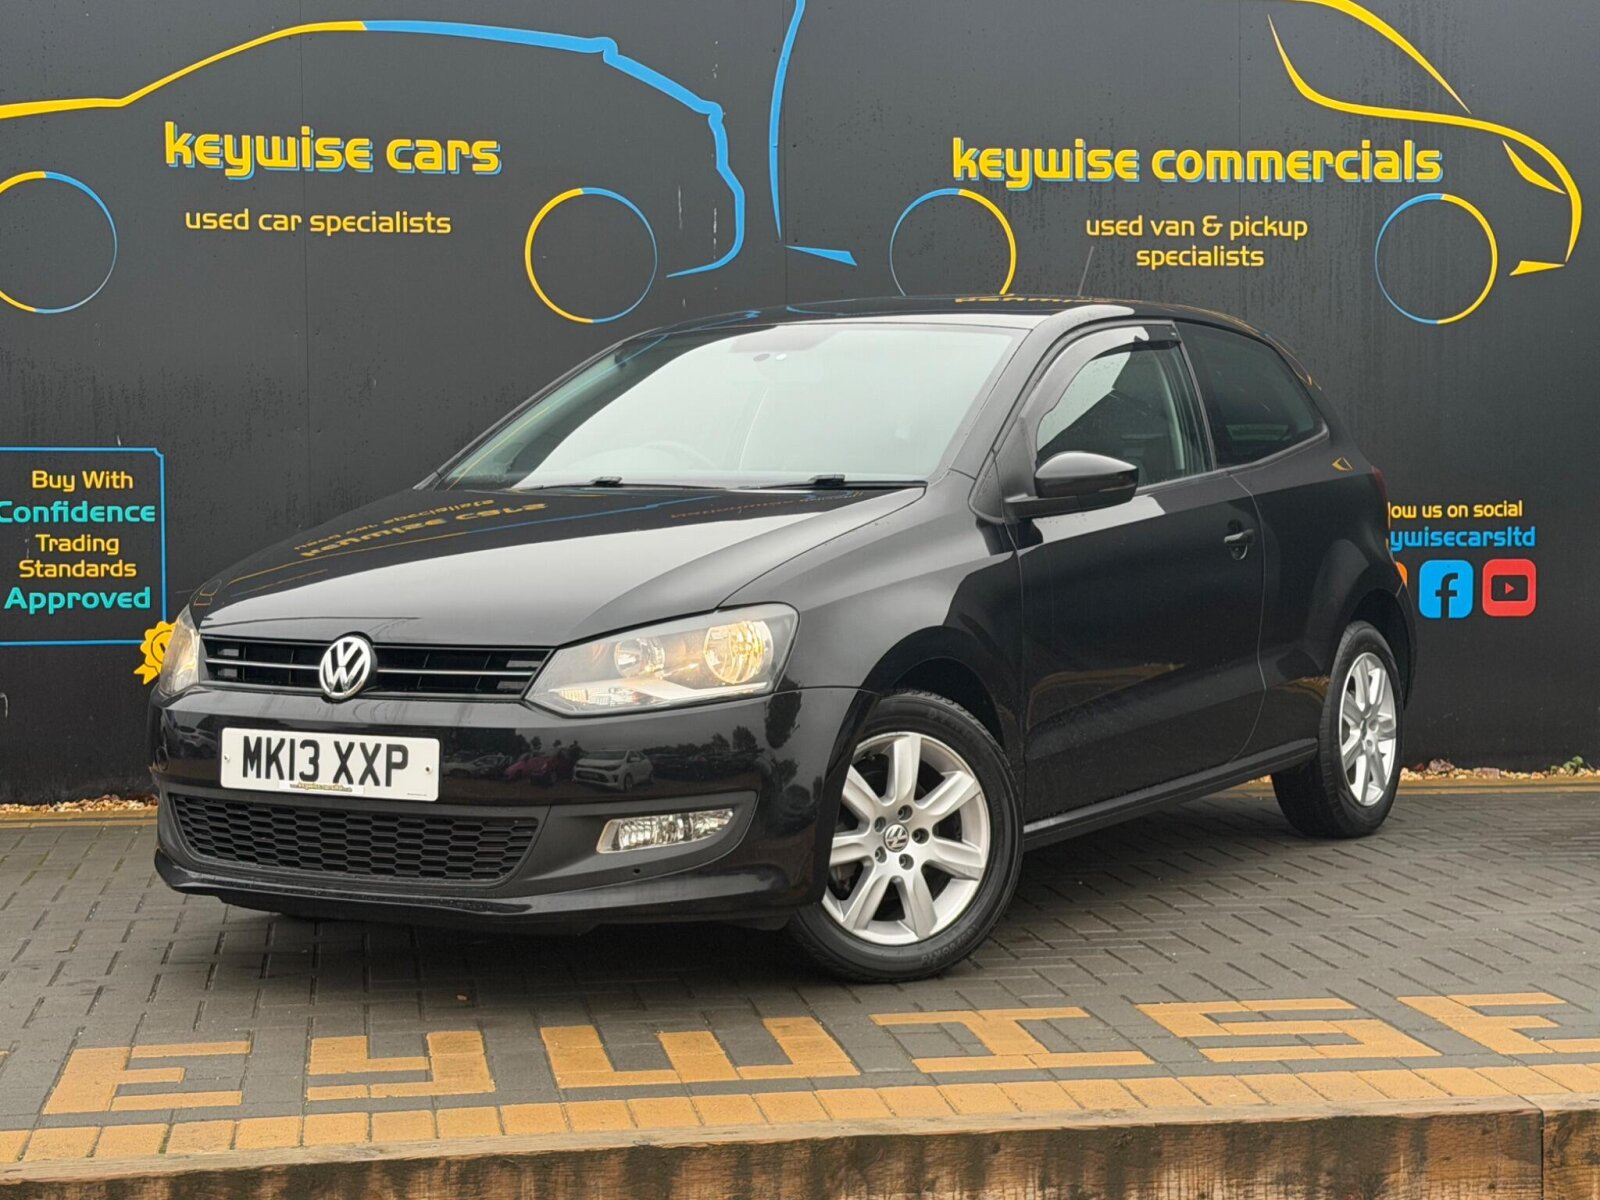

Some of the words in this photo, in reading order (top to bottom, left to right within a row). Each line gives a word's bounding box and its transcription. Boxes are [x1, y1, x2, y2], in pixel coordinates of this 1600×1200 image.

[164, 121, 373, 181] keywise
[386, 138, 502, 175] cars
[952, 137, 1139, 190] keywise
[1151, 139, 1444, 183] commercials
[185, 209, 249, 231] used
[258, 212, 301, 232] car
[310, 211, 451, 235] specialists
[1086, 216, 1143, 236] used
[1150, 219, 1195, 236] van
[1202, 216, 1222, 237] &
[1230, 216, 1308, 240] pickup
[1136, 245, 1264, 269] specialists
[32, 470, 75, 492] Buy
[82, 470, 134, 489] With
[0, 501, 156, 523] Confidence
[1422, 504, 1443, 518] us
[1447, 504, 1469, 518] on
[1473, 500, 1523, 518] social
[35, 534, 120, 555] Trading
[1391, 526, 1536, 551] ywisecarsltd
[18, 560, 137, 578] Standards
[4, 586, 151, 614] Approved
[242, 735, 321, 783] MK13
[332, 740, 409, 787] XXP
